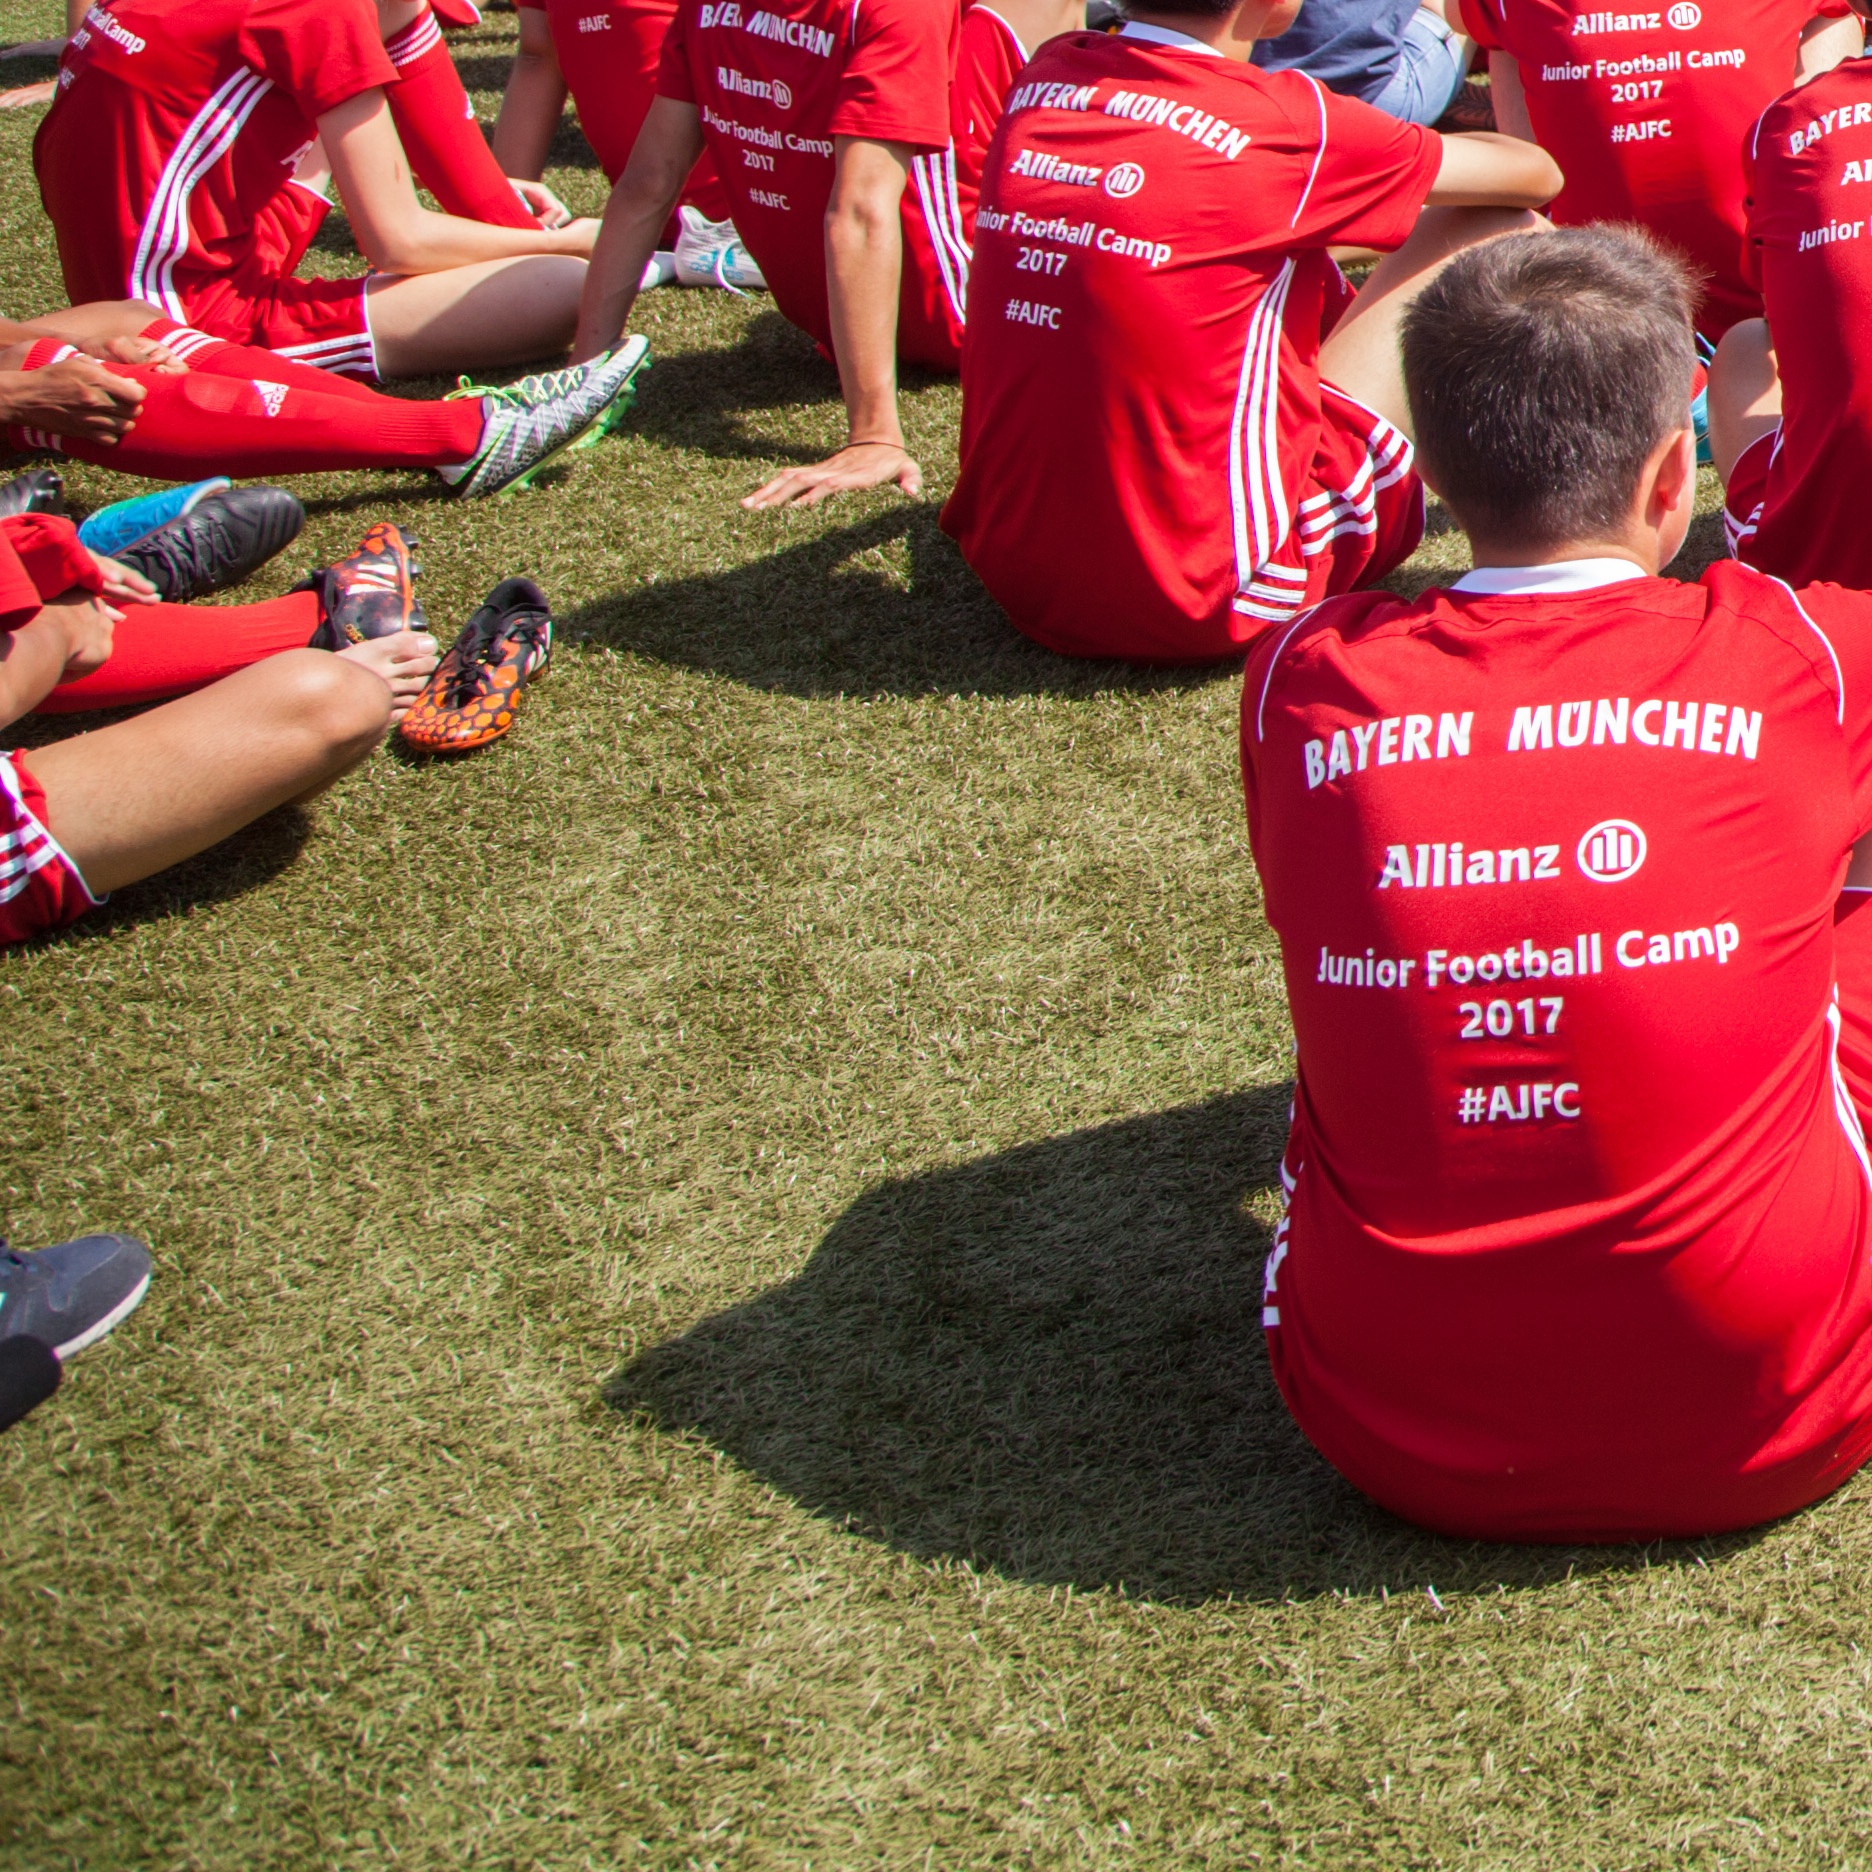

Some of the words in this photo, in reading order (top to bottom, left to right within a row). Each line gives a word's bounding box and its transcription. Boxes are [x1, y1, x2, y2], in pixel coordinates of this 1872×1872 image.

[578, 13, 612, 33] #AJFC
[1570, 9, 1662, 36] Allianz
[1541, 55, 1589, 82] Junior
[1595, 50, 1683, 78] Football
[1686, 47, 1747, 71] Camp
[717, 66, 773, 100] Allianz
[1610, 80, 1663, 103] 2017
[732, 119, 784, 149] Football
[785, 131, 834, 157] Camp
[1009, 80, 1099, 114] BAYERN
[1104, 90, 1251, 160] MÜNCHEN
[1611, 119, 1673, 143] #AJFC
[742, 148, 776, 172] 2017
[1010, 149, 1103, 187] Allianz
[748, 186, 791, 211] #AJFC
[1010, 210, 1096, 247] Football
[1096, 228, 1172, 268] Camp
[1798, 216, 1865, 254] Junior
[1015, 246, 1068, 277] 2017
[1005, 298, 1062, 330] #AJFC
[1304, 710, 1475, 791] BAYERN
[1506, 696, 1763, 761] MÜNCHEN
[1378, 841, 1562, 890] Allianz
[1317, 946, 1415, 988] Junior
[1426, 933, 1602, 987] Football
[1615, 920, 1741, 969] Camp
[1459, 995, 1564, 1040] 2017
[1457, 1082, 1581, 1124] #AJFC
